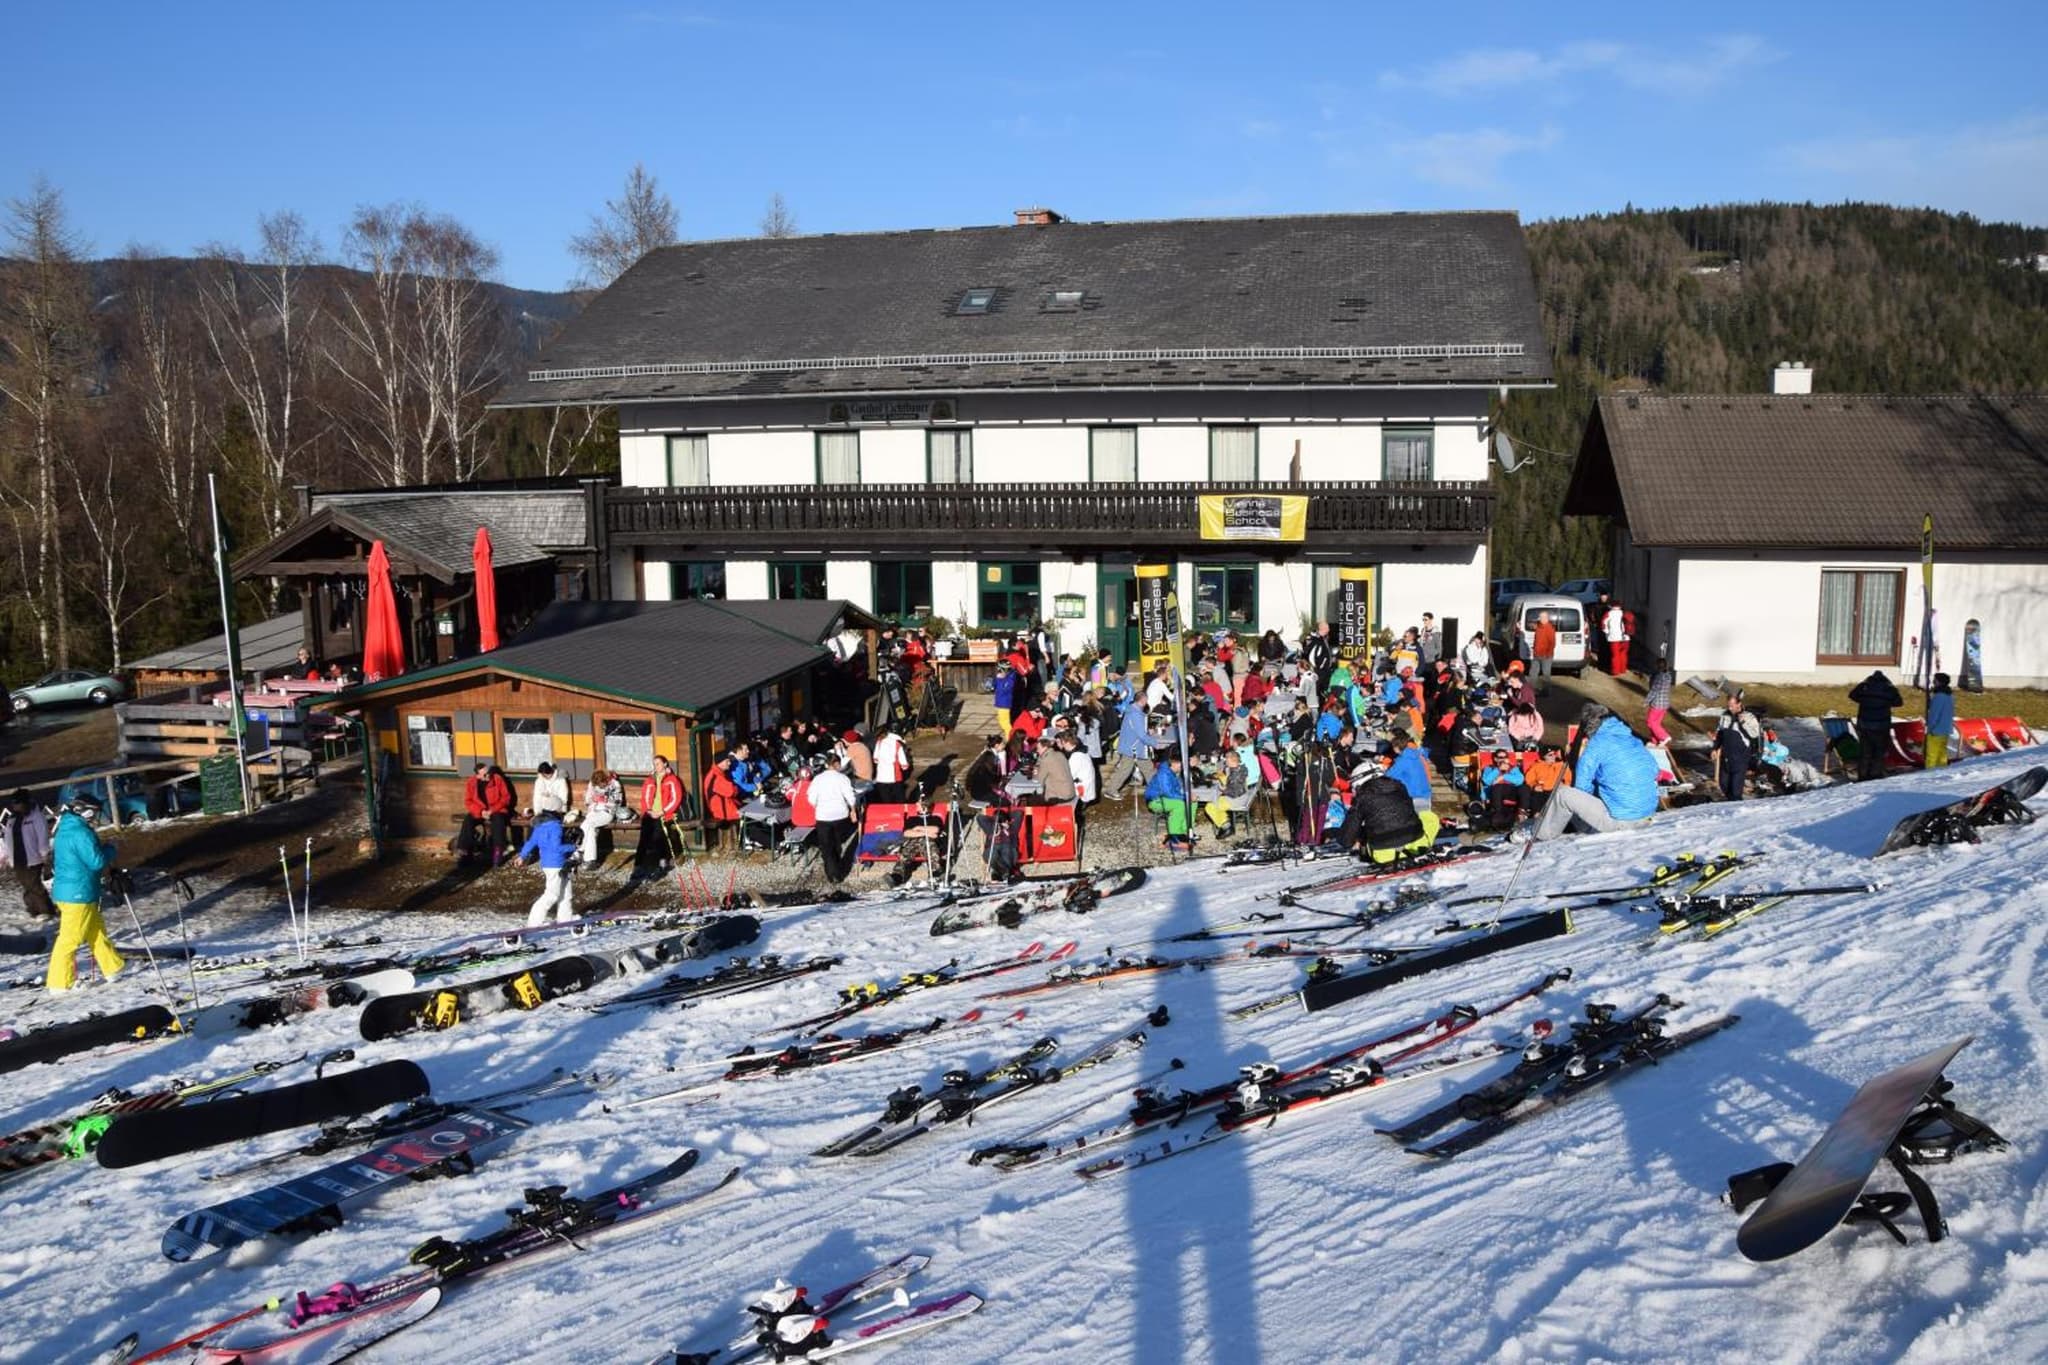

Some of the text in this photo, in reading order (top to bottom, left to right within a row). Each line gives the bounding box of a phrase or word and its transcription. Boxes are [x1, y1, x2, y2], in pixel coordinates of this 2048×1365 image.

[1225, 499, 1266, 509] Vienna
[1225, 508, 1280, 517] Business
[1225, 517, 1267, 526] School
[1142, 598, 1152, 654] Vienna
[1152, 578, 1164, 654] Business
[1343, 582, 1354, 658] Business
